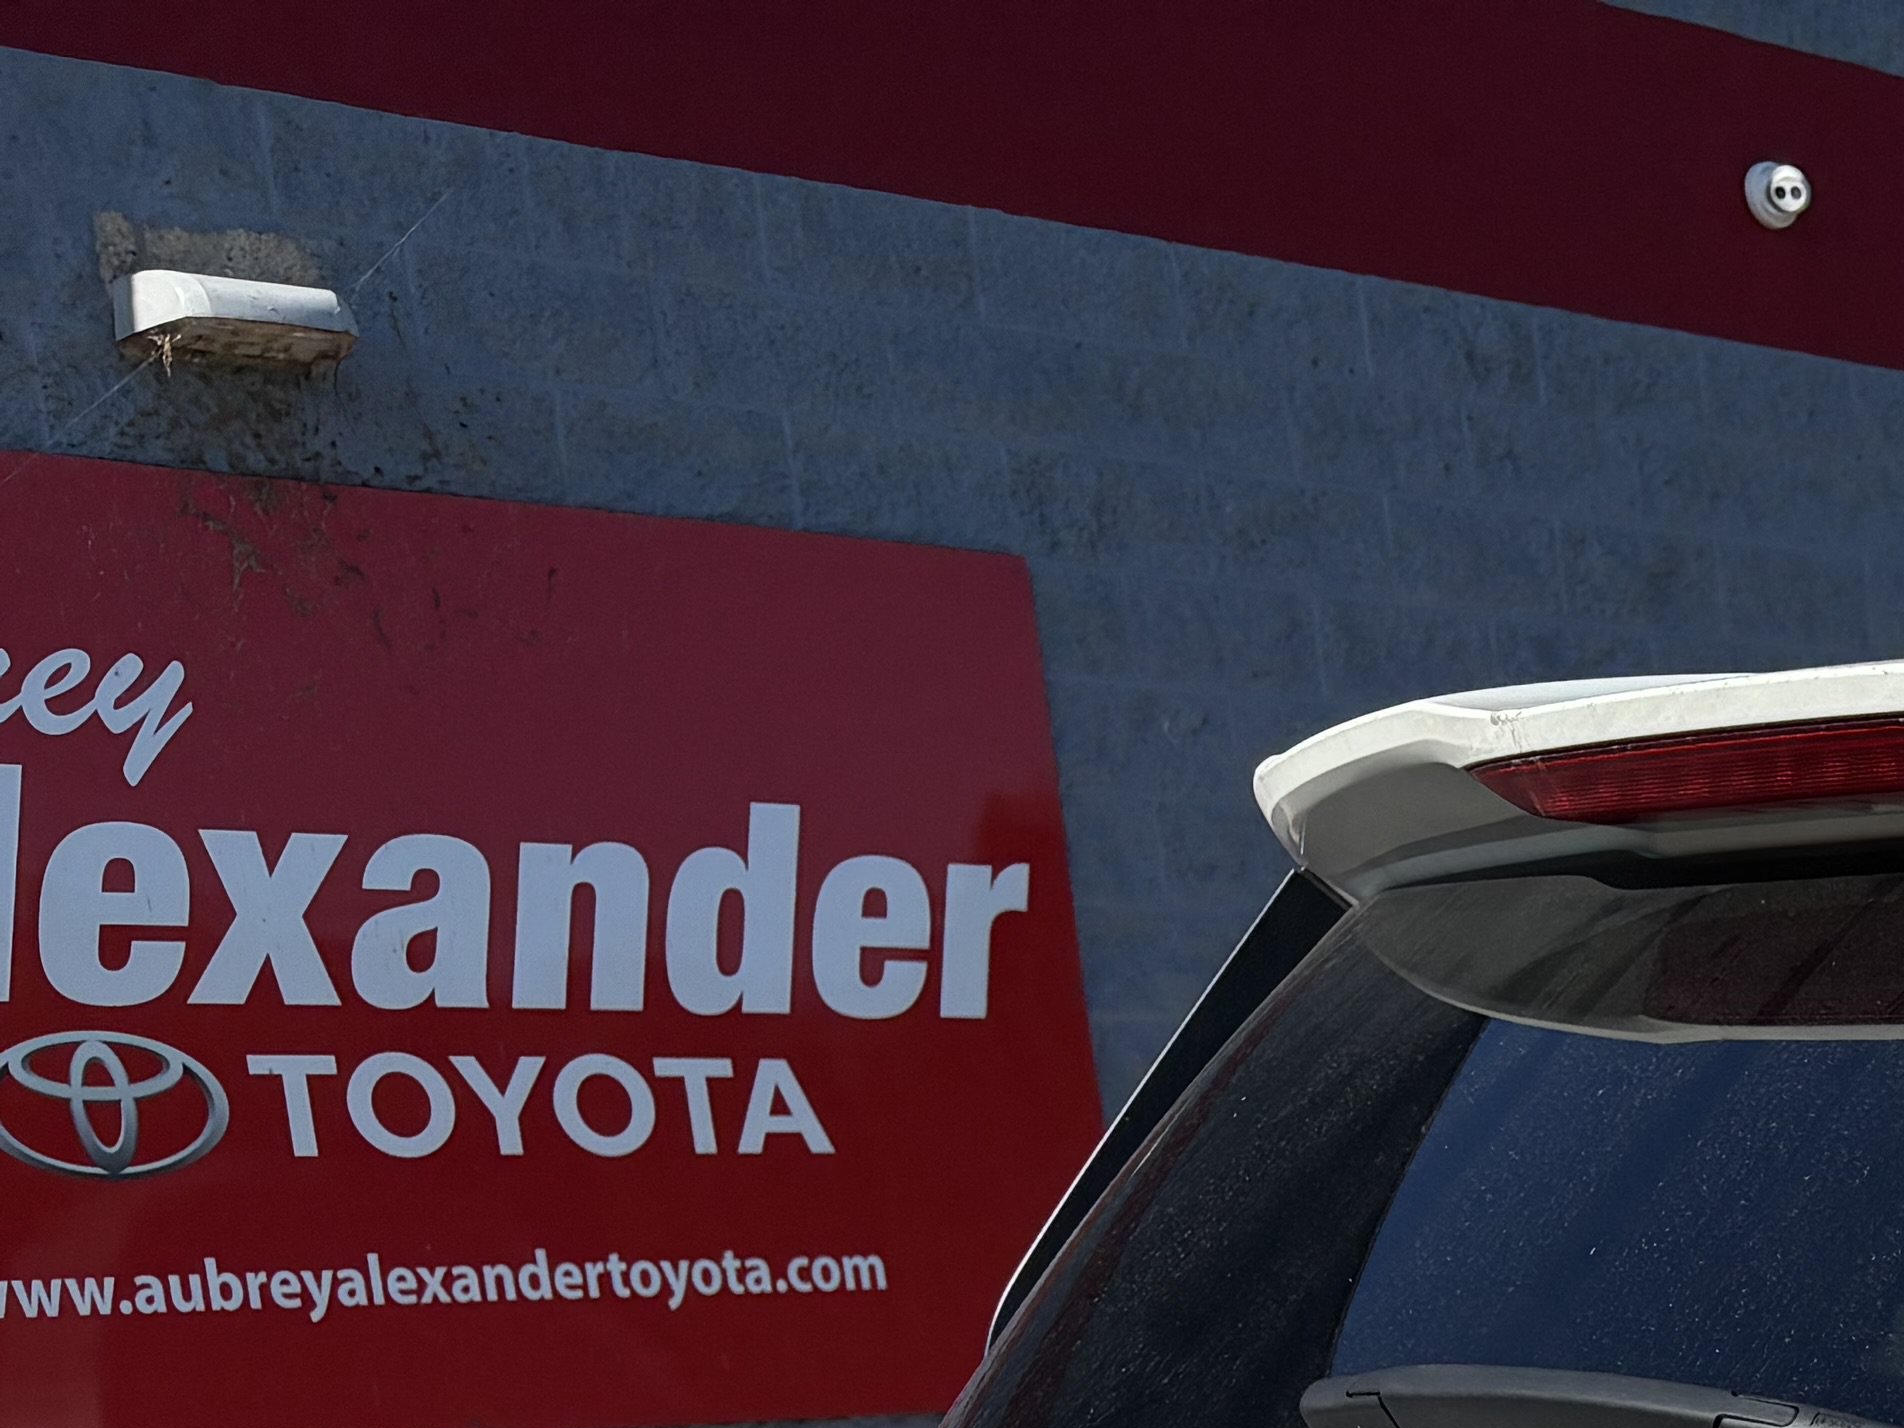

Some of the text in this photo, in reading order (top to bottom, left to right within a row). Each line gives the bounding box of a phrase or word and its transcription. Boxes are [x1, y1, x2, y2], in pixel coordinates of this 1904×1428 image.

[0, 647, 193, 786] ey
[247, 1051, 835, 1158] TOYOTA
[0, 1248, 887, 1323] ww.aubreyalexandertoyota.com
